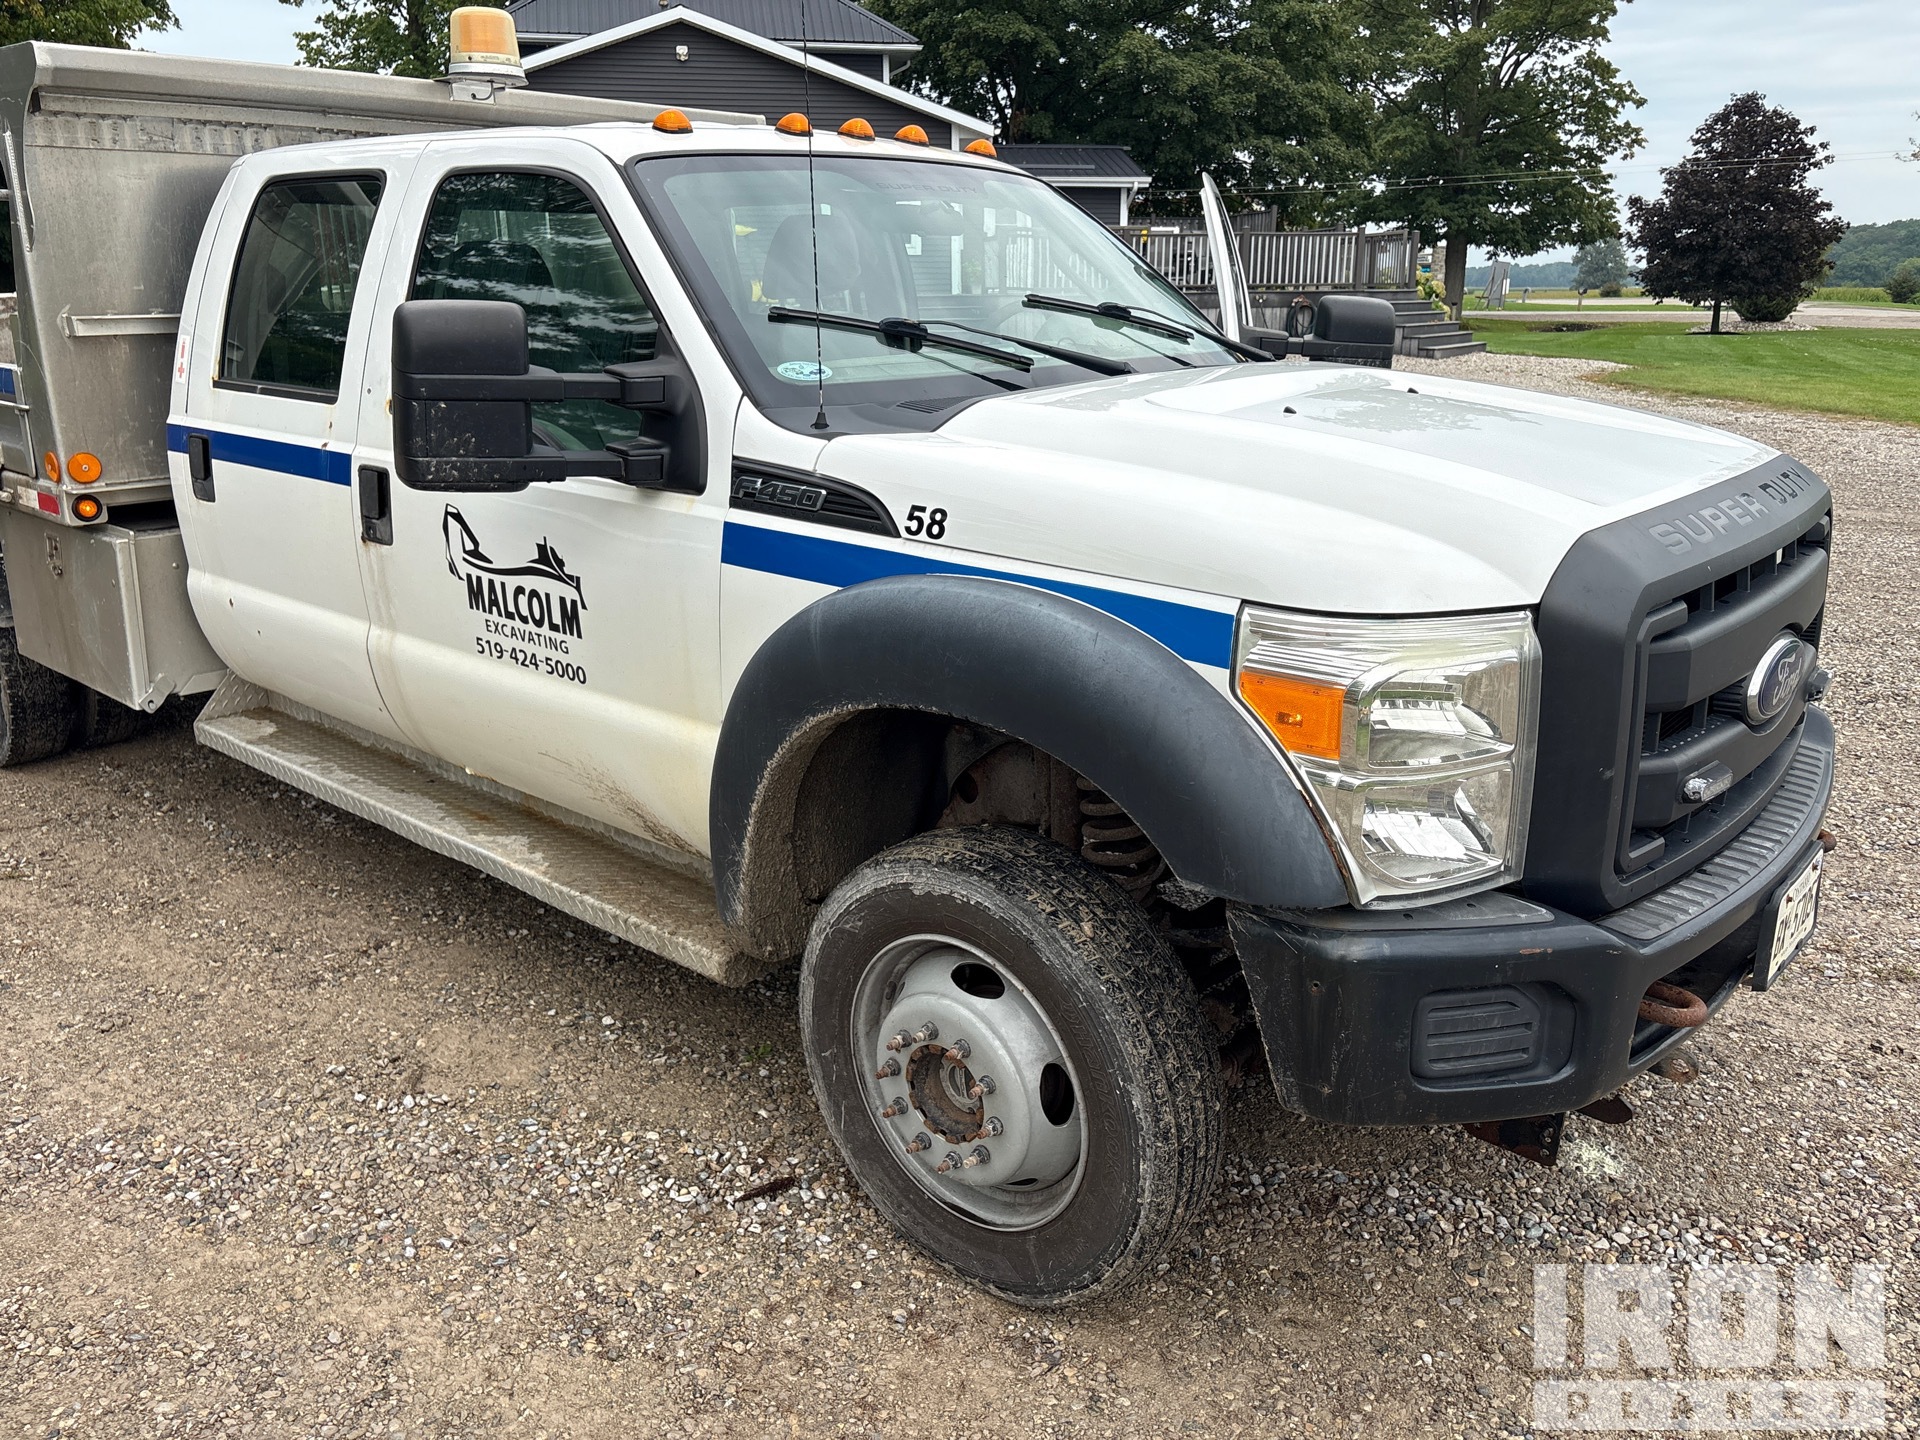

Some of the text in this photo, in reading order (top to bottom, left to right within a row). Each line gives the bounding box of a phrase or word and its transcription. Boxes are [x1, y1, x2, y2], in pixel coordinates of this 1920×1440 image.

[875, 182, 978, 194] SUPER DUTY
[731, 476, 828, 511] F-450
[1648, 467, 1811, 555] SUPER DUTY
[904, 504, 948, 539] 58
[466, 572, 583, 639] MALCOLM
[485, 618, 569, 655] EXCAVATING
[476, 636, 587, 685] 519-424-5000
[1772, 652, 1802, 706] Ford
